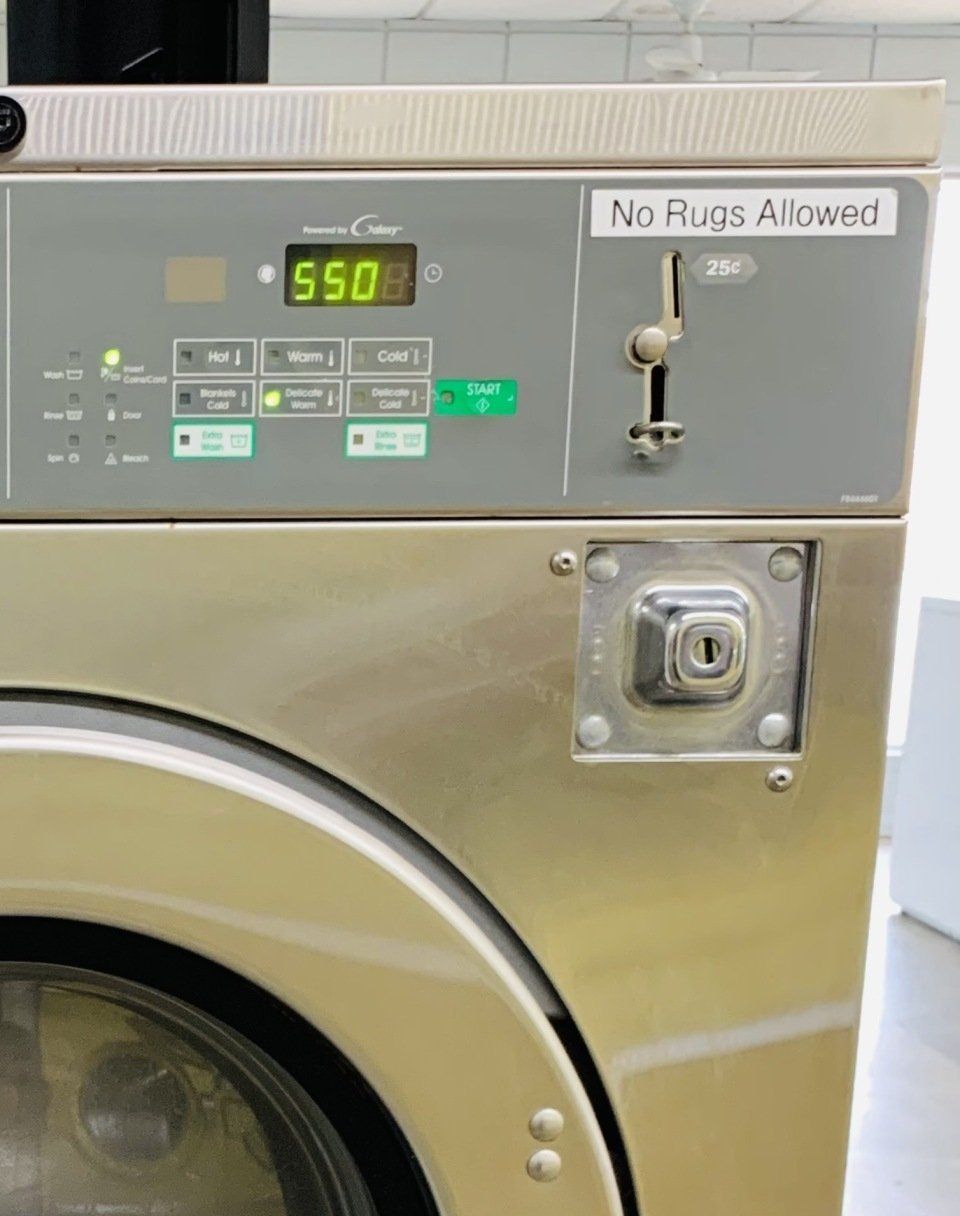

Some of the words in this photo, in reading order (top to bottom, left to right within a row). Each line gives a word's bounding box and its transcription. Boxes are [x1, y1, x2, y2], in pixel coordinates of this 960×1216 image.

[611, 199, 654, 228] No
[665, 199, 745, 232] Rugs
[756, 198, 879, 227] Allowed
[303, 226, 337, 235] Powered
[337, 226, 348, 235] by
[350, 214, 399, 237] Galaxy
[208, 350, 230, 364] Hot
[287, 351, 324, 364] Warm
[377, 351, 409, 363] Cold
[43, 370, 65, 380] Wash
[200, 388, 237, 399] Blankets
[285, 388, 324, 398] Delicate
[371, 388, 410, 398] Delicate
[467, 383, 502, 396] START
[206, 400, 230, 411] Cold
[290, 400, 318, 410] Warm
[378, 399, 402, 410] Cold
[202, 431, 223, 440] Extra
[376, 430, 398, 439] Extra
[201, 443, 224, 452] Wash
